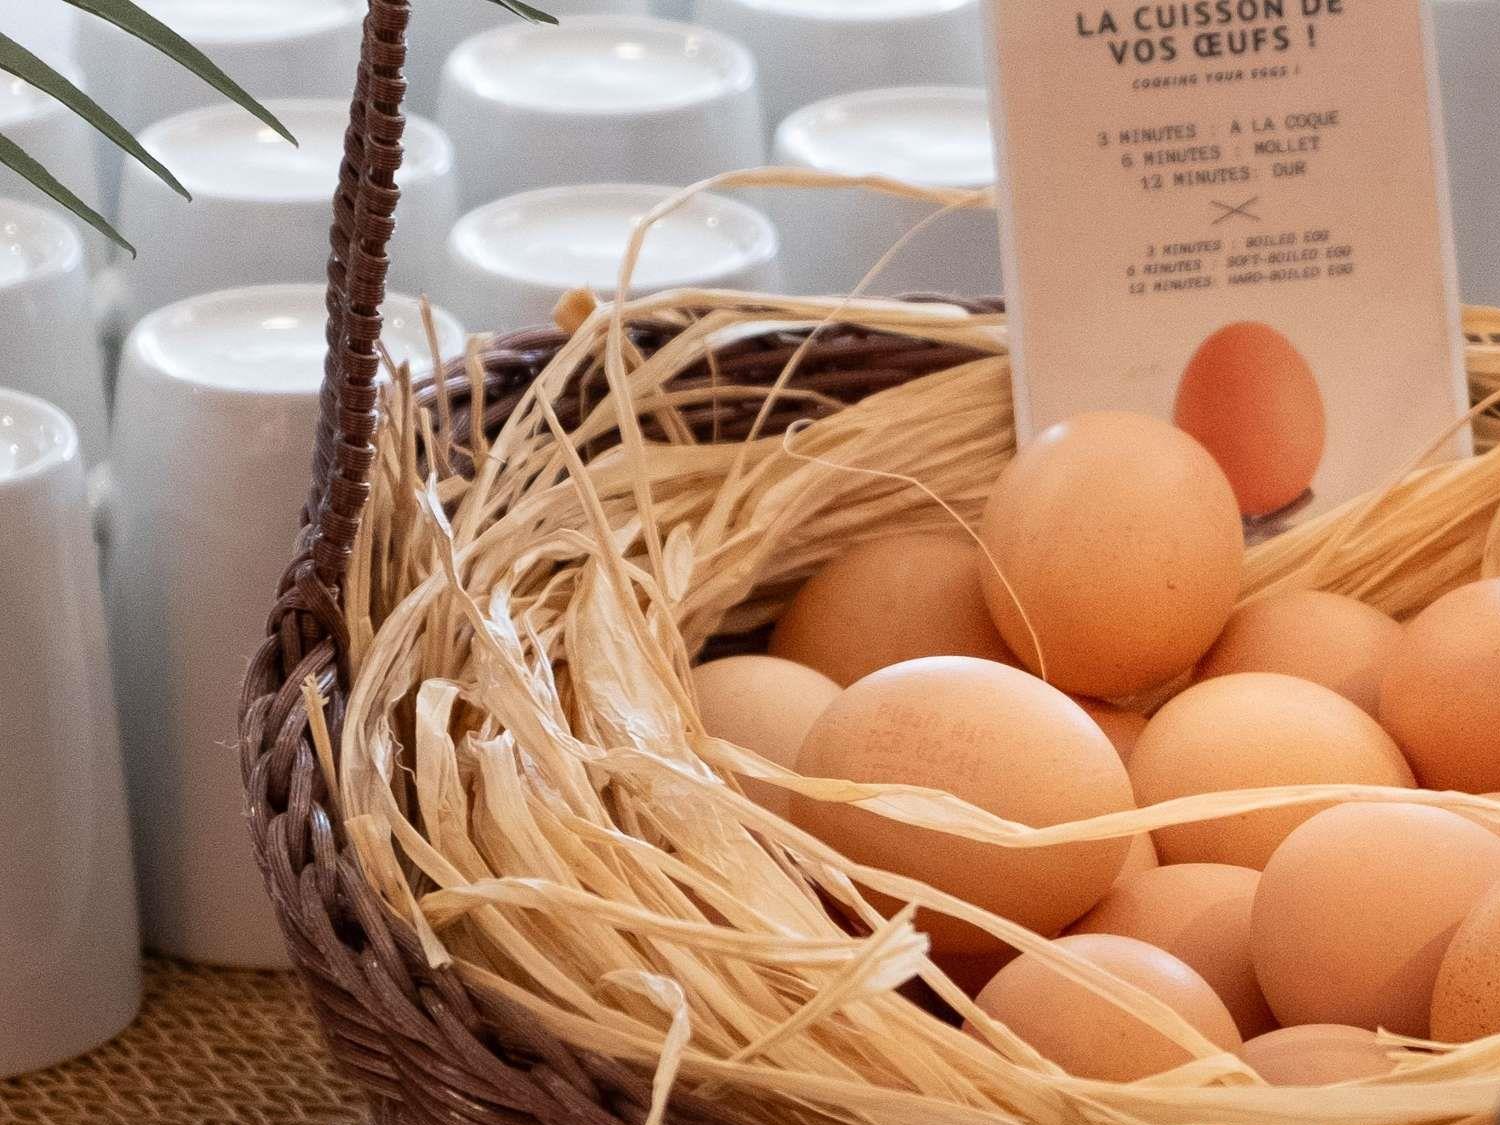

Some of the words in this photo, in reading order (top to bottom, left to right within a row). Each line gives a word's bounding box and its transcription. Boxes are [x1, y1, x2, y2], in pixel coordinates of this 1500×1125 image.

[1076, 11, 1117, 37] LA
[1133, 0, 1284, 31] CUISSON
[1302, 0, 1343, 16] DE
[1107, 36, 1177, 64] VOS
[1193, 25, 1289, 58] ŒUFS
[1132, 73, 1197, 89] COOKING
[1205, 69, 1243, 84] YOUR
[1250, 66, 1288, 79] EGGS
[1097, 131, 1109, 147] 3
[1119, 123, 1197, 144] MINUTES
[1252, 117, 1275, 132] LA
[1284, 110, 1339, 130] COQUE
[1121, 152, 1133, 168] 6
[1143, 145, 1221, 166] MINUTES
[1254, 135, 1320, 155] MOLLET
[1140, 173, 1163, 190] 12
[1272, 160, 1306, 178] DUR
[1162, 239, 1222, 256] MINUTES
[1246, 232, 1296, 248] BOILED
[1303, 229, 1330, 243] EGG
[1143, 259, 1202, 275] MINUTES
[1227, 248, 1318, 268] SOFT-BOILED
[1326, 245, 1352, 259] EGG
[1129, 282, 1145, 294] 12
[1228, 266, 1320, 285] HARD-BOILED
[1327, 262, 1354, 277] EGG
